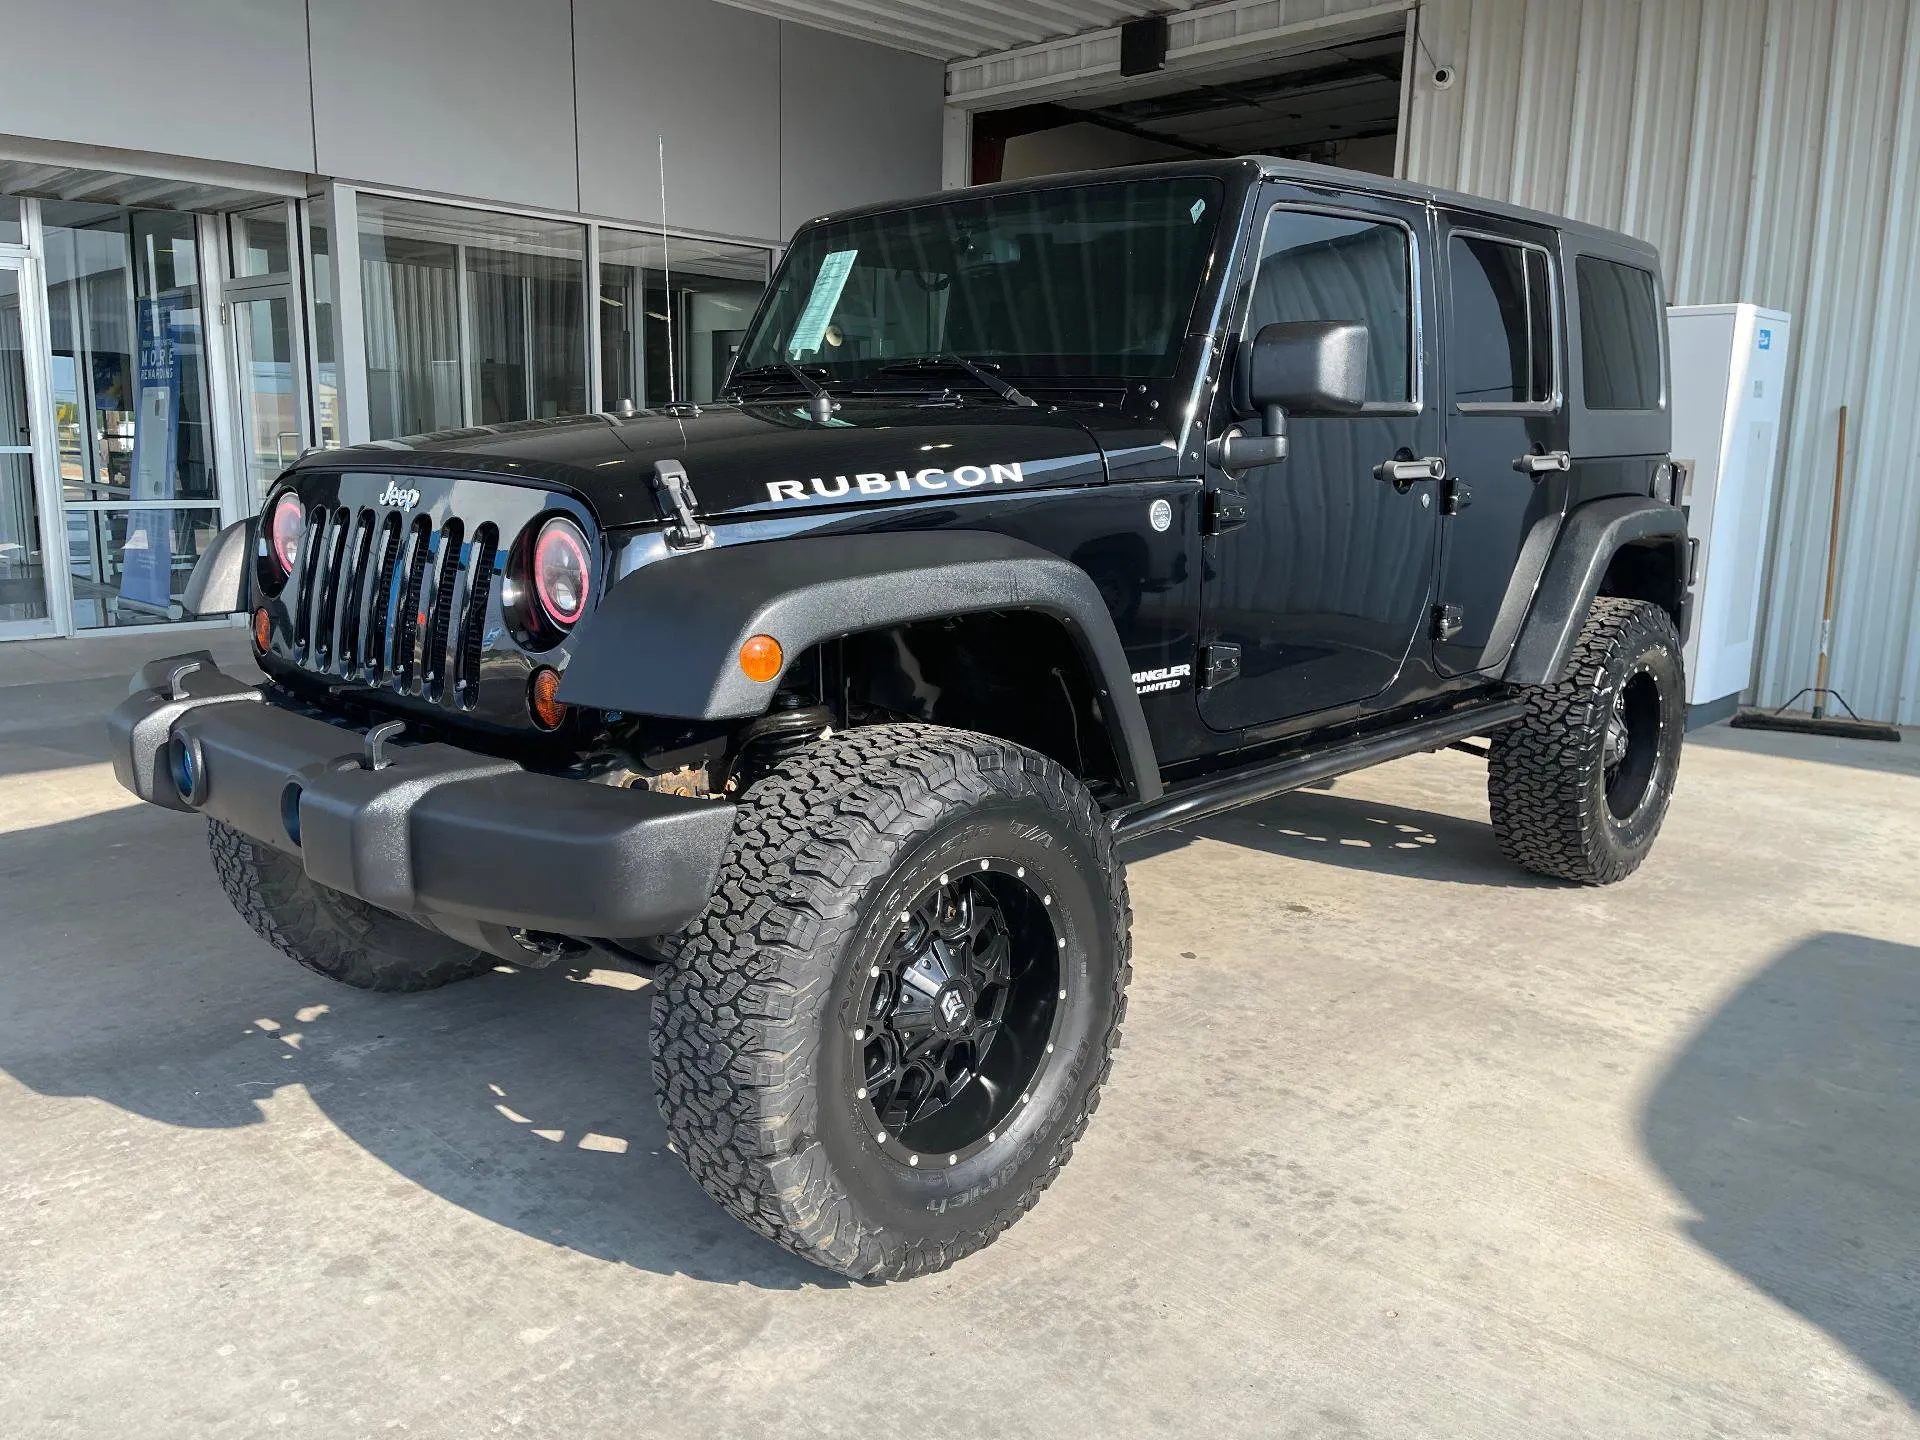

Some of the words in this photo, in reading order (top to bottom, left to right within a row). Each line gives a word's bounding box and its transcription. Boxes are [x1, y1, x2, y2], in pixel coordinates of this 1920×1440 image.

[141, 348, 174, 367] MORE
[379, 480, 421, 513] Jeep
[765, 462, 1025, 502] RUBICON
